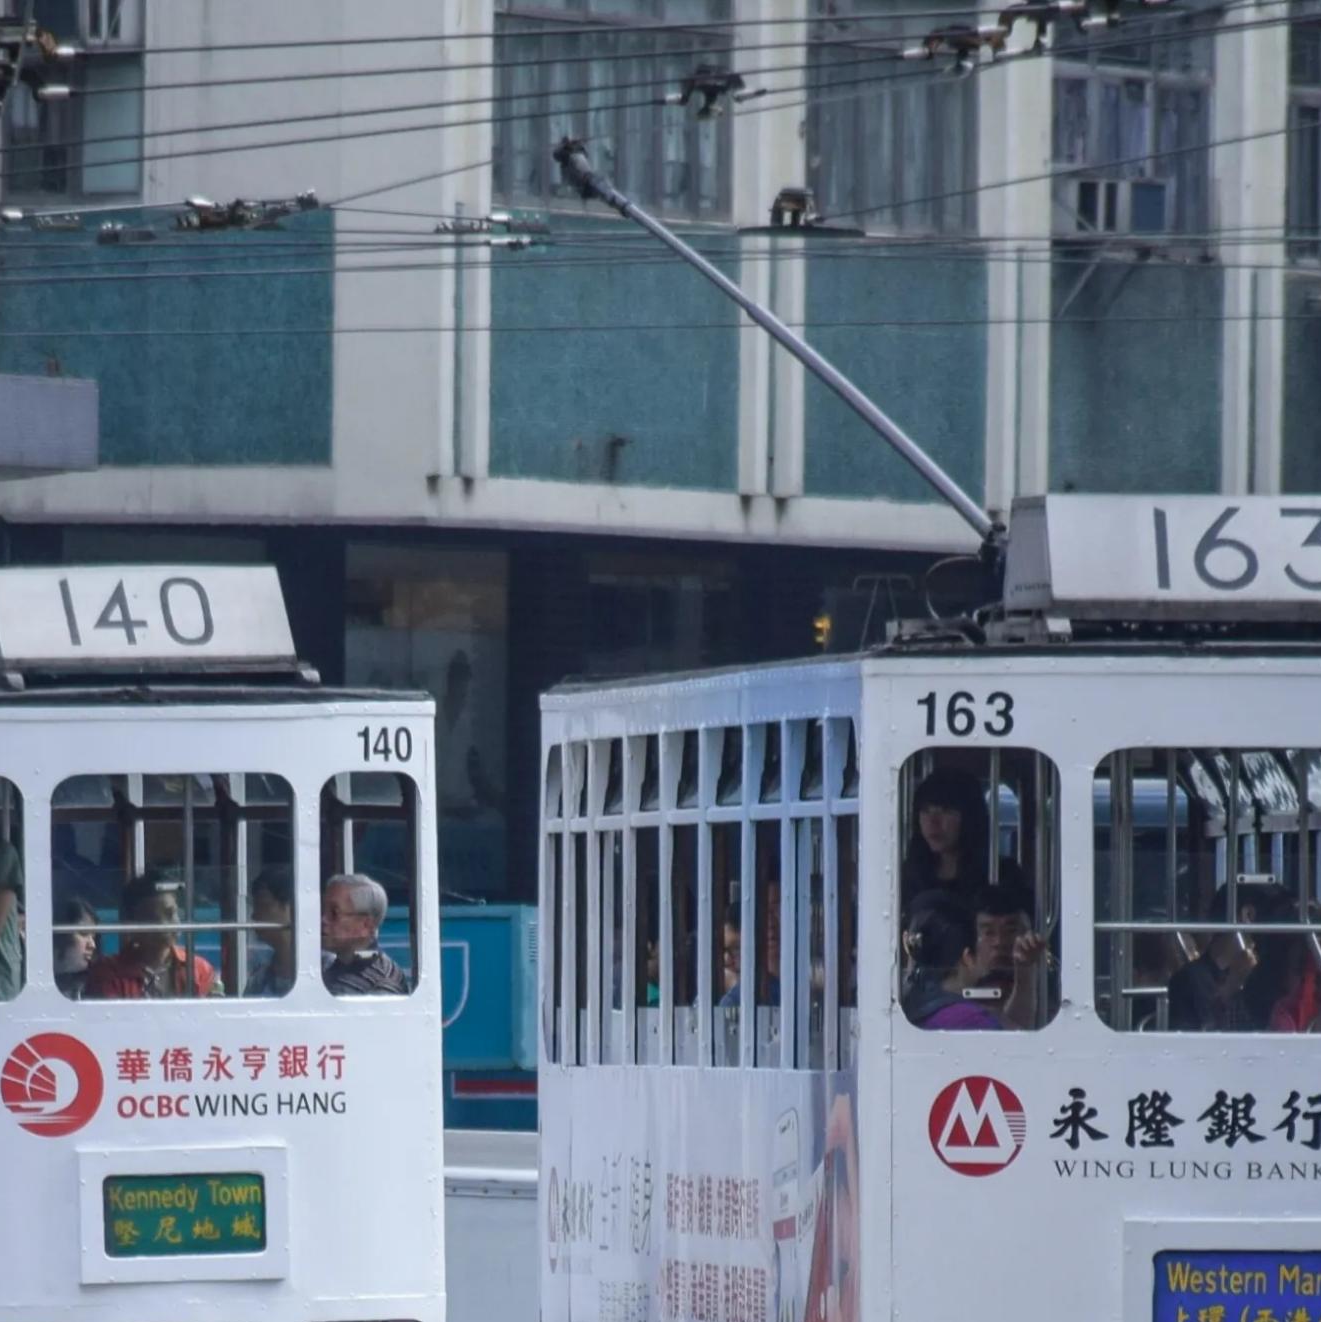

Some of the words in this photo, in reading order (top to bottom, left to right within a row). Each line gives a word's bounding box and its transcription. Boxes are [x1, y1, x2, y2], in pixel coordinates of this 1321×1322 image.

[59, 576, 215, 646] 140
[917, 691, 1015, 738] 163
[357, 726, 413, 763] 140
[116, 1045, 346, 1083] 華僑永亨銀行
[117, 1095, 190, 1118] OCBC
[195, 1093, 268, 1117] WING
[278, 1091, 347, 1115] HANG
[1054, 1158, 1134, 1181] WING
[1149, 1159, 1235, 1181] LUNG
[109, 1183, 198, 1213] Kennedy
[207, 1180, 262, 1206] Town
[1166, 1261, 1267, 1295] Western
